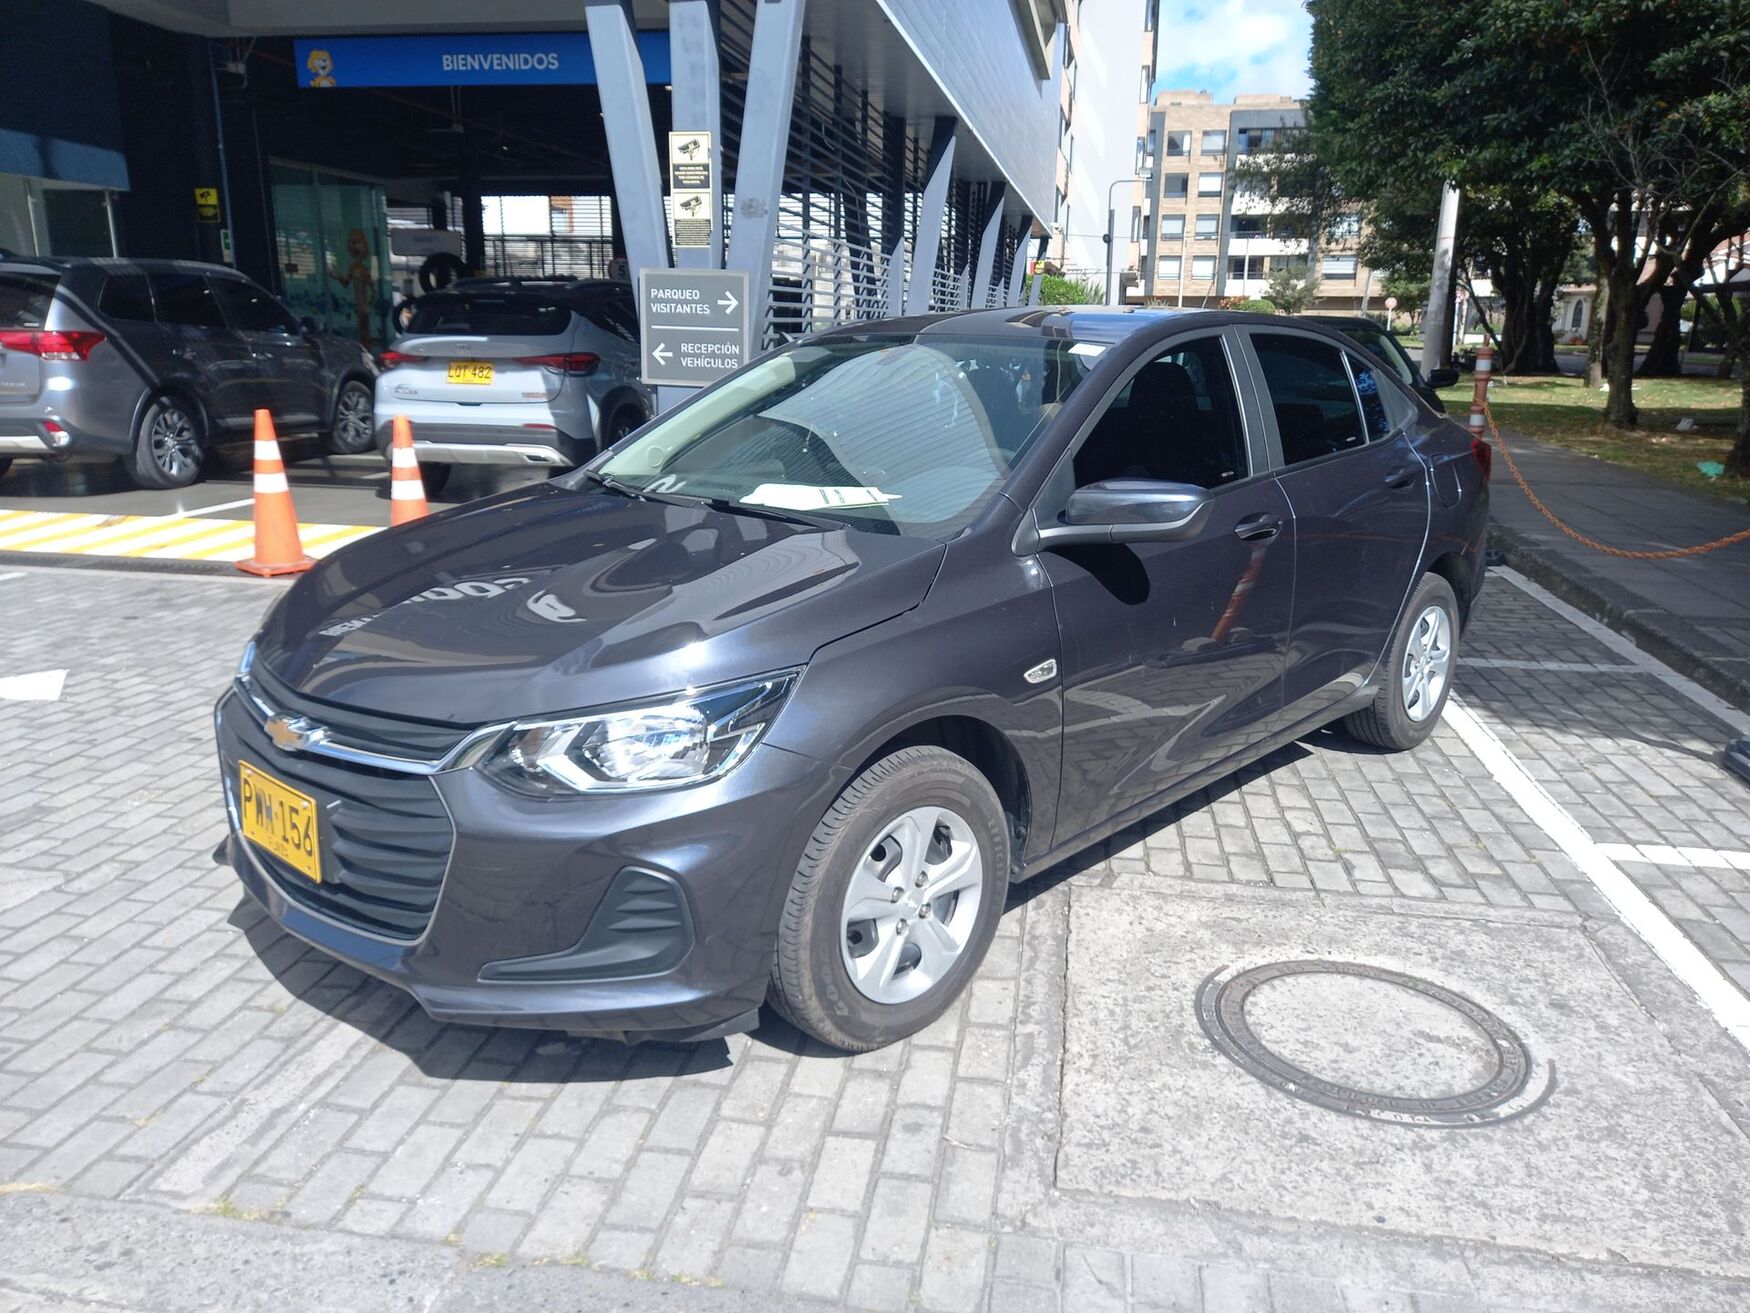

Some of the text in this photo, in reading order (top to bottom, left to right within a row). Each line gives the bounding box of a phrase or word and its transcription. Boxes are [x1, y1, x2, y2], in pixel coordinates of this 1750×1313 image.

[442, 53, 559, 71] BIENVENIDOS
[650, 288, 700, 300] PARQUEO
[650, 303, 711, 315] VISITANTES
[680, 341, 740, 354] RECEPCIÓN
[680, 355, 739, 369] VEHÍCULOS
